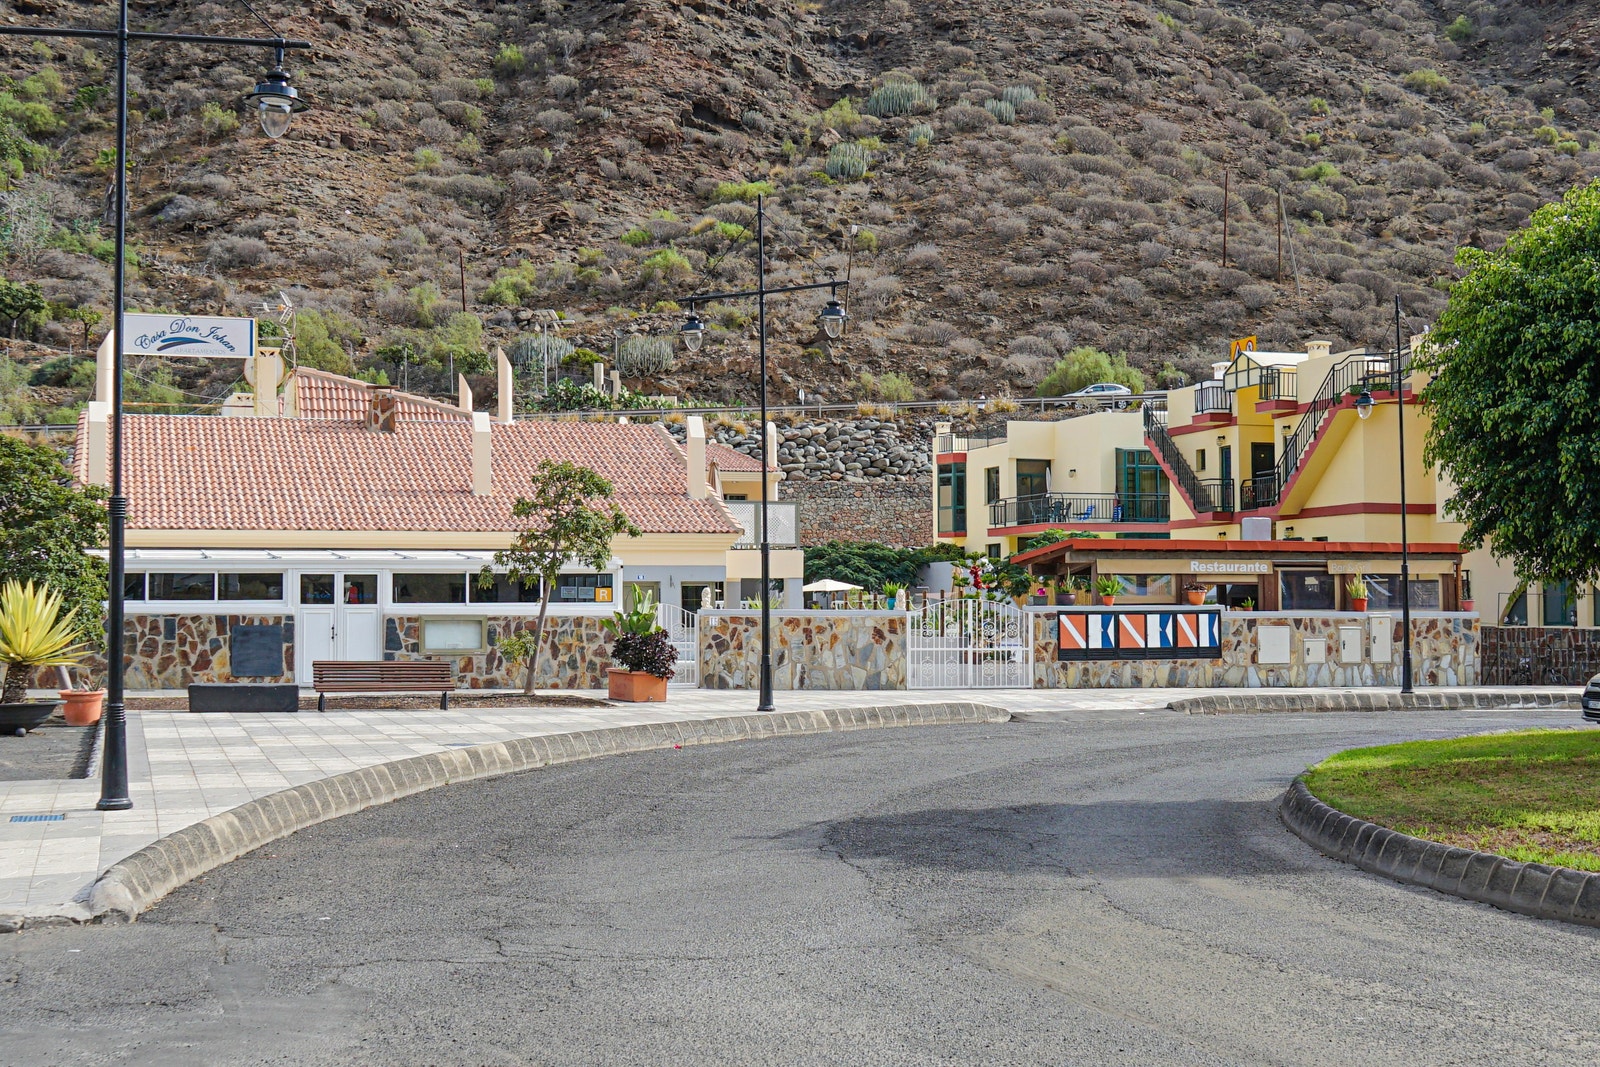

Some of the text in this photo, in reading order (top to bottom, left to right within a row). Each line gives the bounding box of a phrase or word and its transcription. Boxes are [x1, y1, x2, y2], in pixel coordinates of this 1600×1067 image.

[134, 317, 236, 353] Casa Don Johan
[1190, 560, 1268, 572] Restaurante
[1332, 563, 1345, 572] Bar
[599, 589, 608, 600] R
